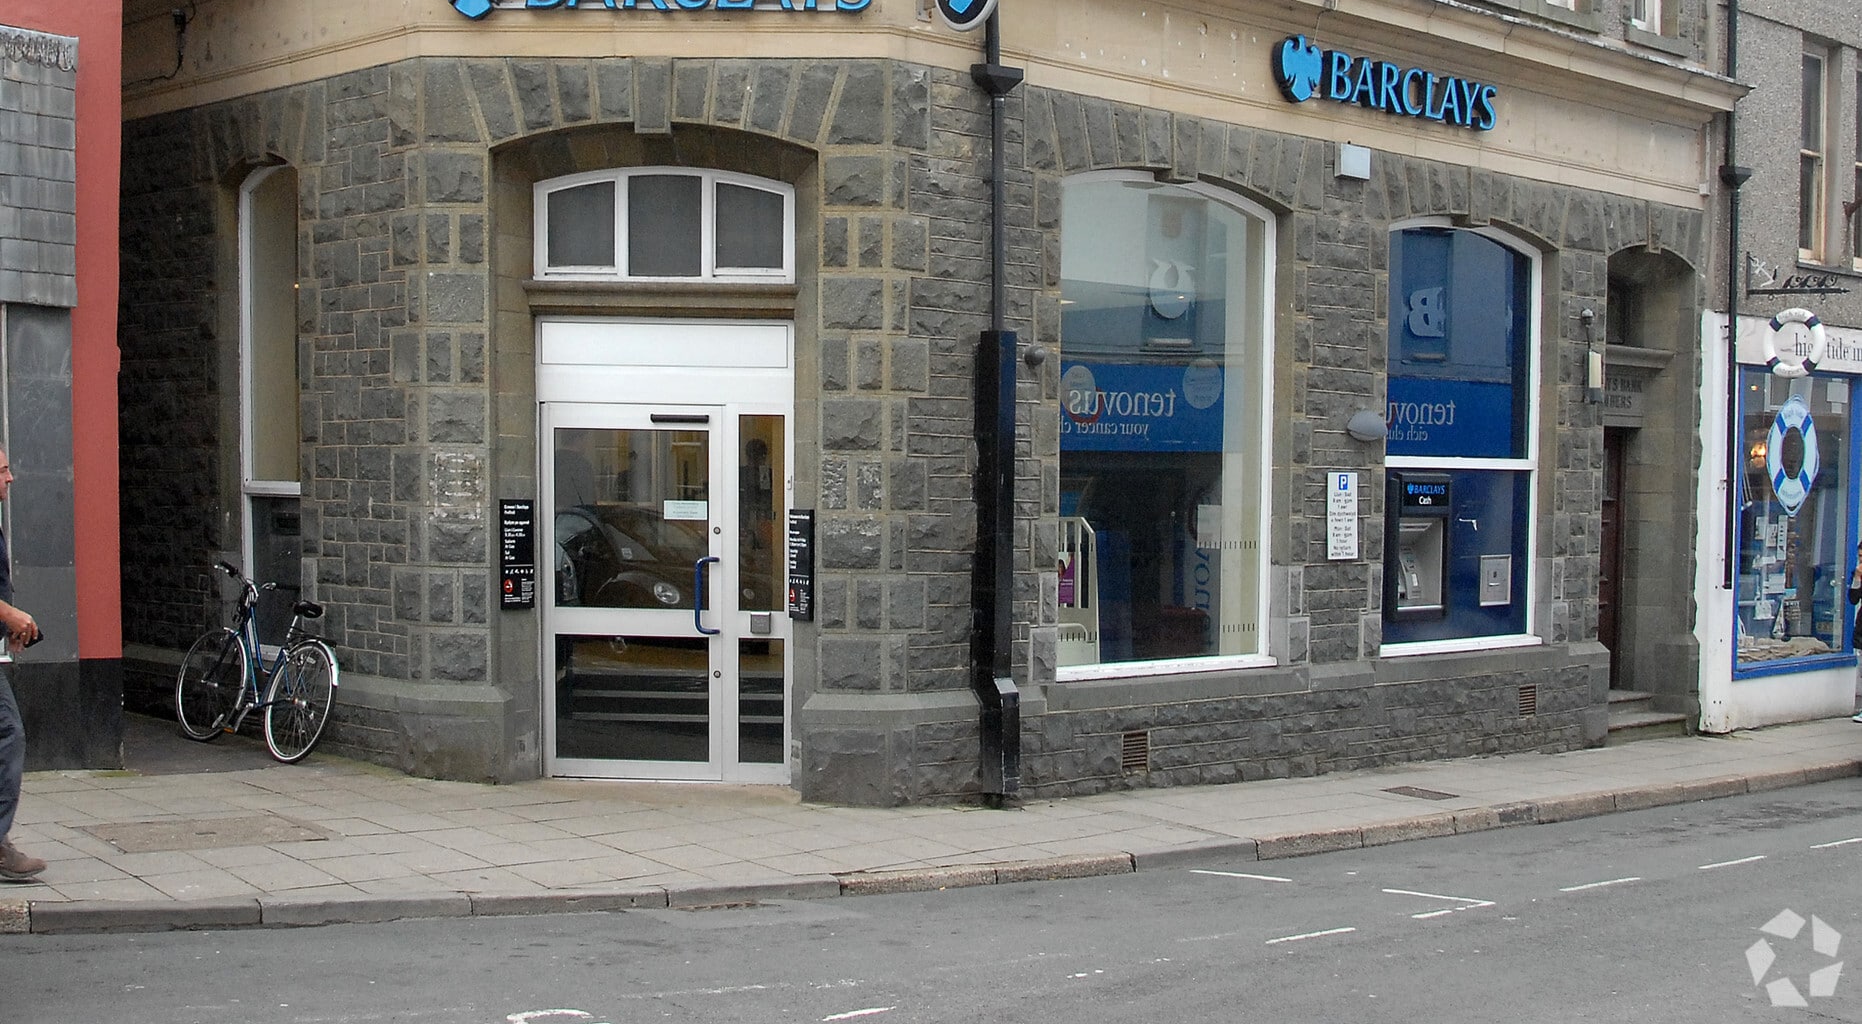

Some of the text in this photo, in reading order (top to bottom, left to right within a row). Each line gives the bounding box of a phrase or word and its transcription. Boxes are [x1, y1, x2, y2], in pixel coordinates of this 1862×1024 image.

[1320, 49, 1498, 131] BARCLAYS
[1826, 337, 1849, 361] tide
[1414, 484, 1446, 495] BARCLAYS
[1418, 495, 1432, 505] Cash
